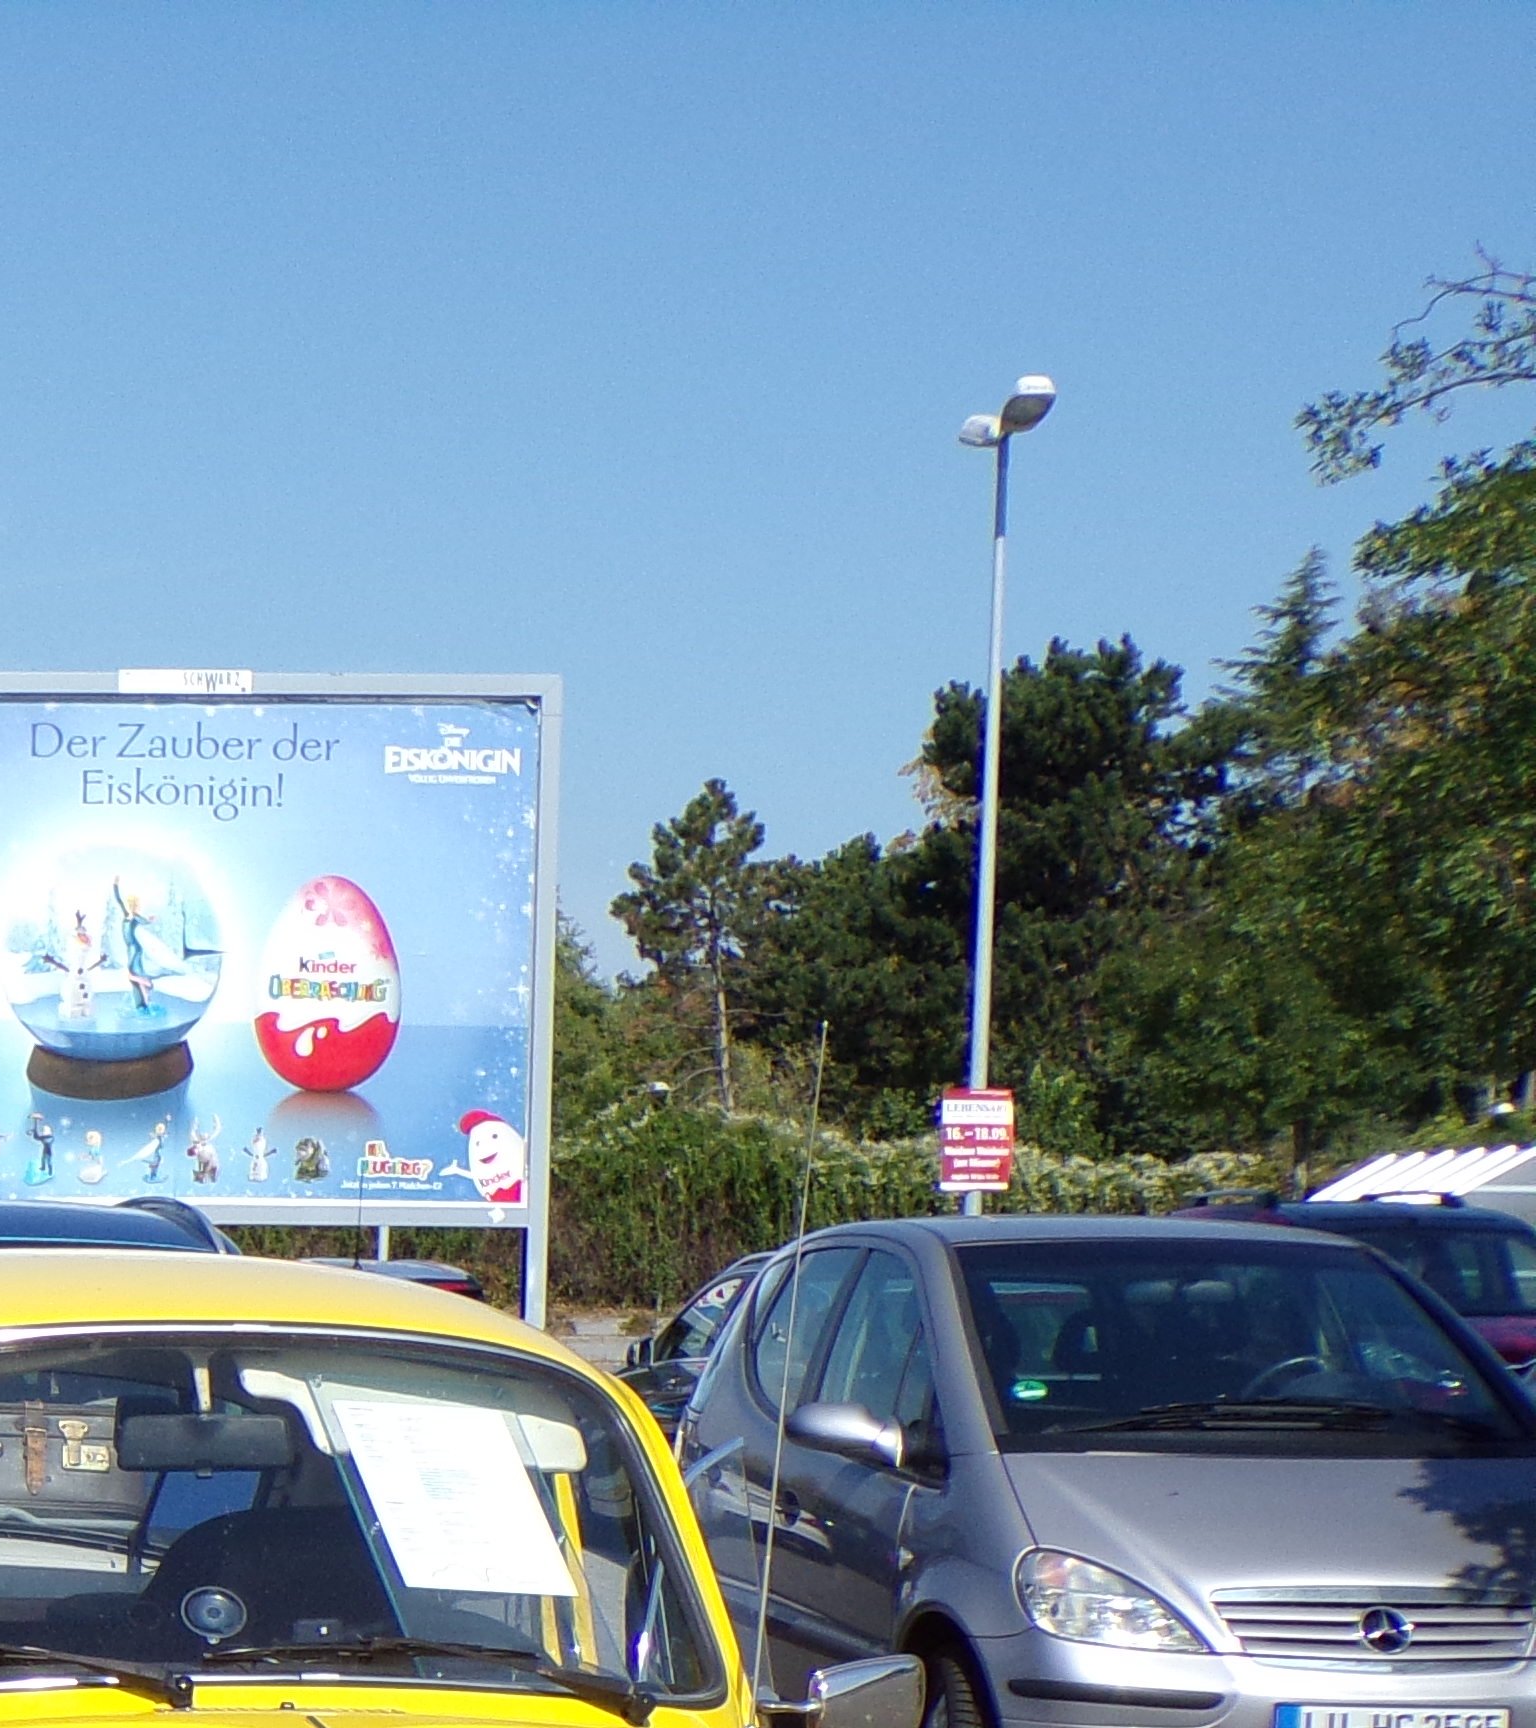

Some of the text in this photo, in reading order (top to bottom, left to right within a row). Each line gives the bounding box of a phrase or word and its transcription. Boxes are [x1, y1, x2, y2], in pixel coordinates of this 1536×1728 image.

[30, 720, 340, 761] Der Zauber der
[82, 767, 284, 822] Eiskönigin!
